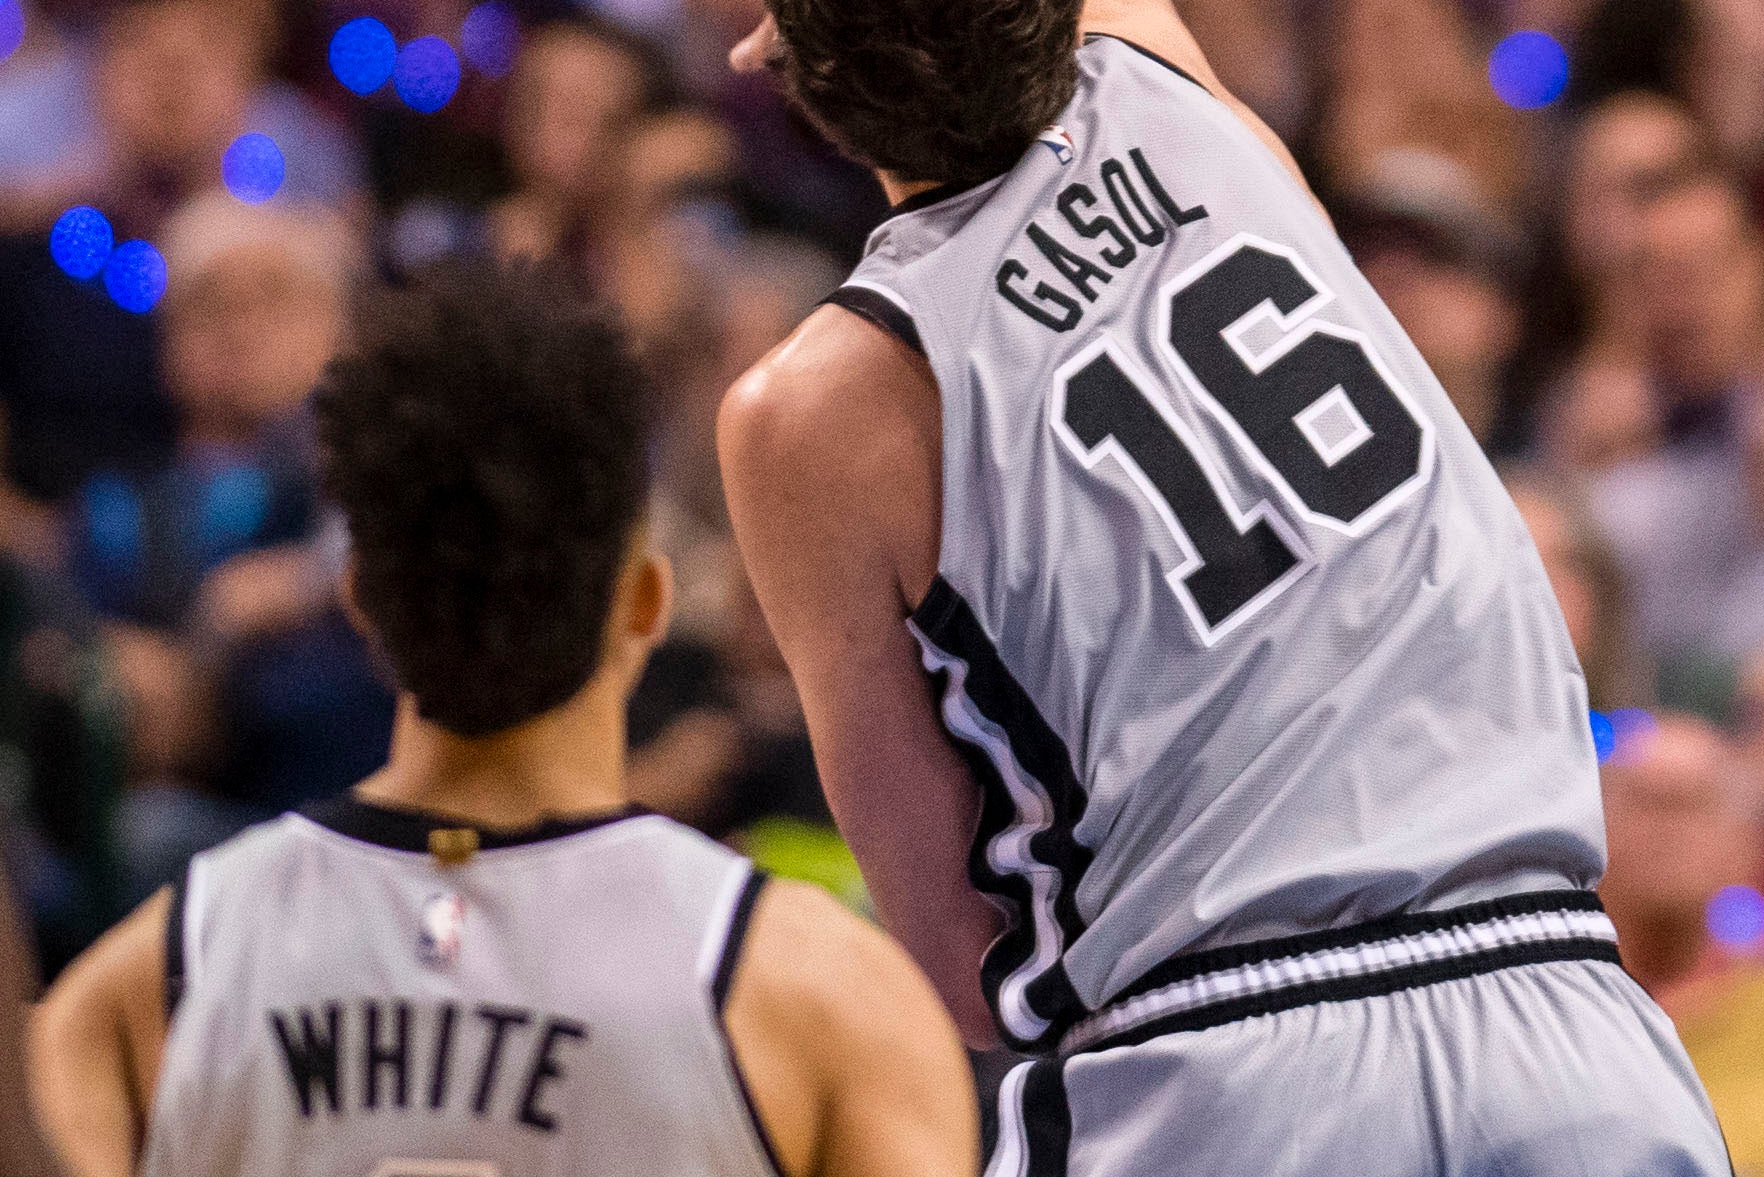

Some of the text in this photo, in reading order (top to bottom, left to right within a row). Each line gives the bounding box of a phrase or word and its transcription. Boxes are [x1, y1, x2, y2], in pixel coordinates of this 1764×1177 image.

[994, 147, 1209, 333] GASOL
[1051, 231, 1436, 647] 16
[268, 1000, 589, 1132] WHITE
